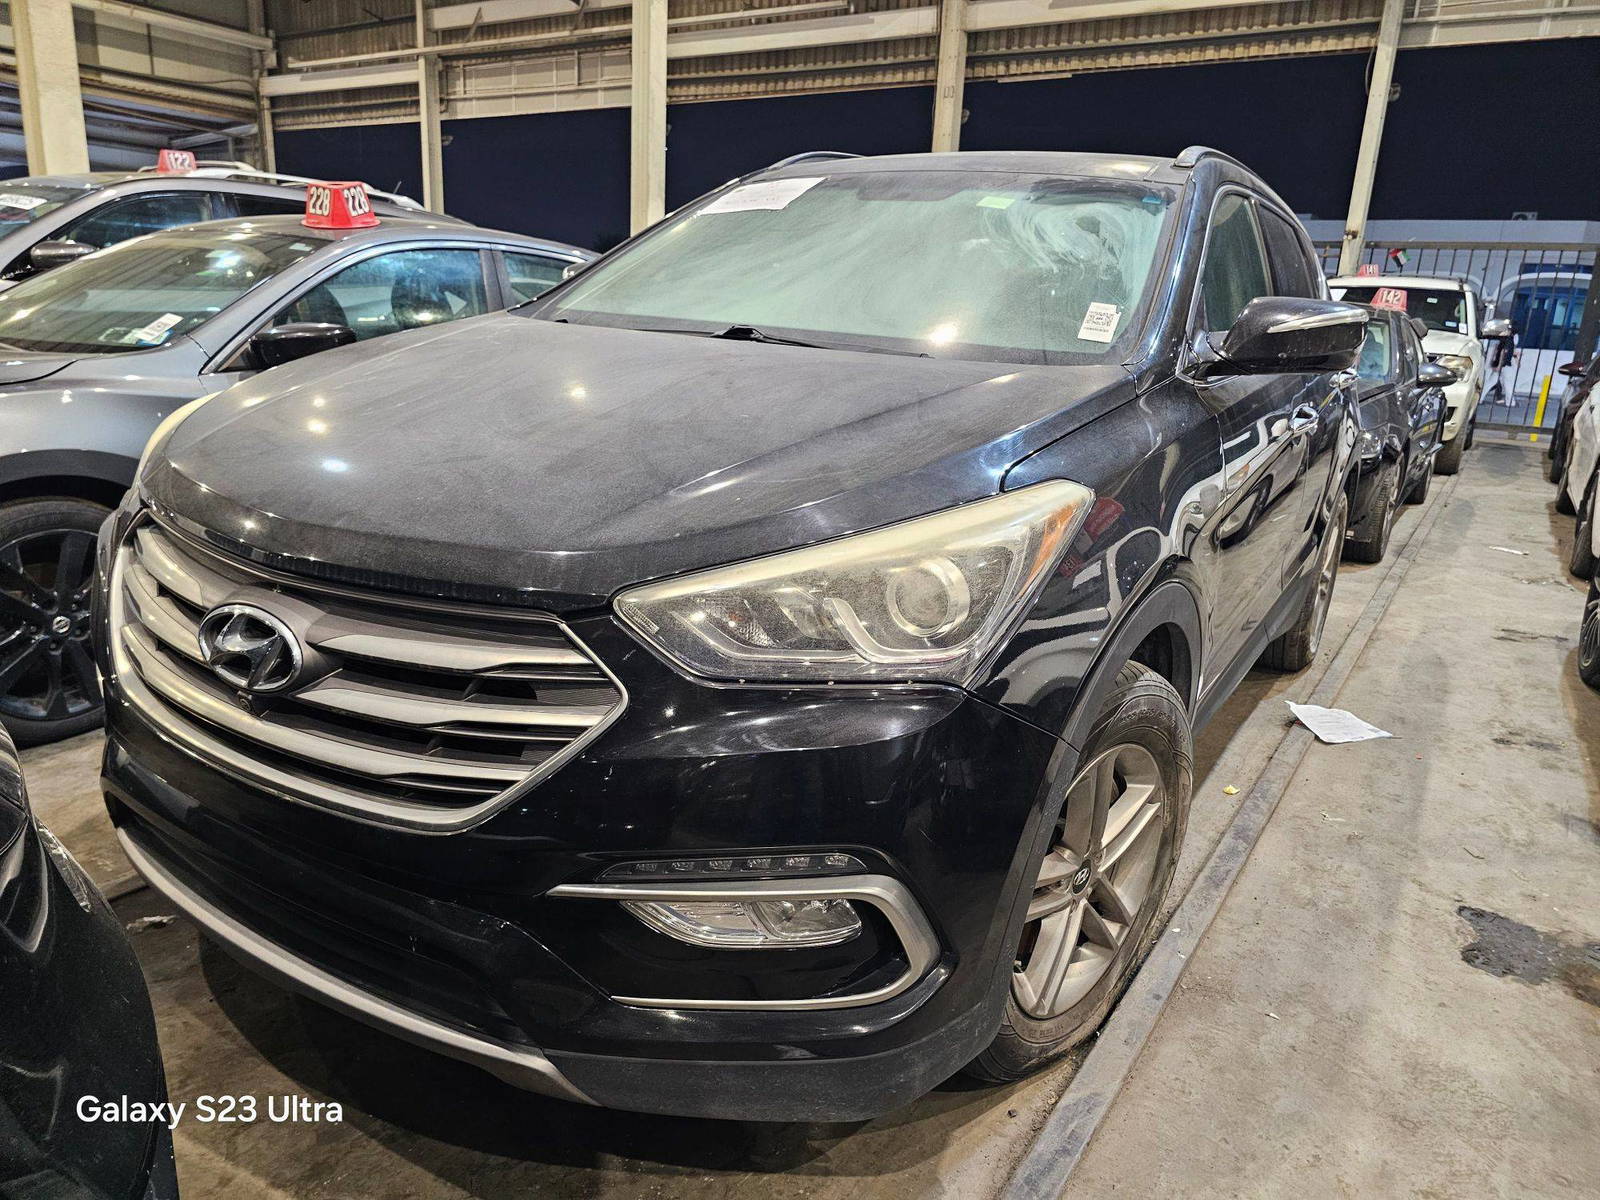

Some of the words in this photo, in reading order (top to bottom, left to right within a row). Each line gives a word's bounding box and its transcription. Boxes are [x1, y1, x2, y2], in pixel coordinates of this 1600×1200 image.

[168, 152, 191, 169] 122
[309, 186, 331, 217] 228
[343, 186, 370, 217] 228
[1382, 289, 1401, 305] 142
